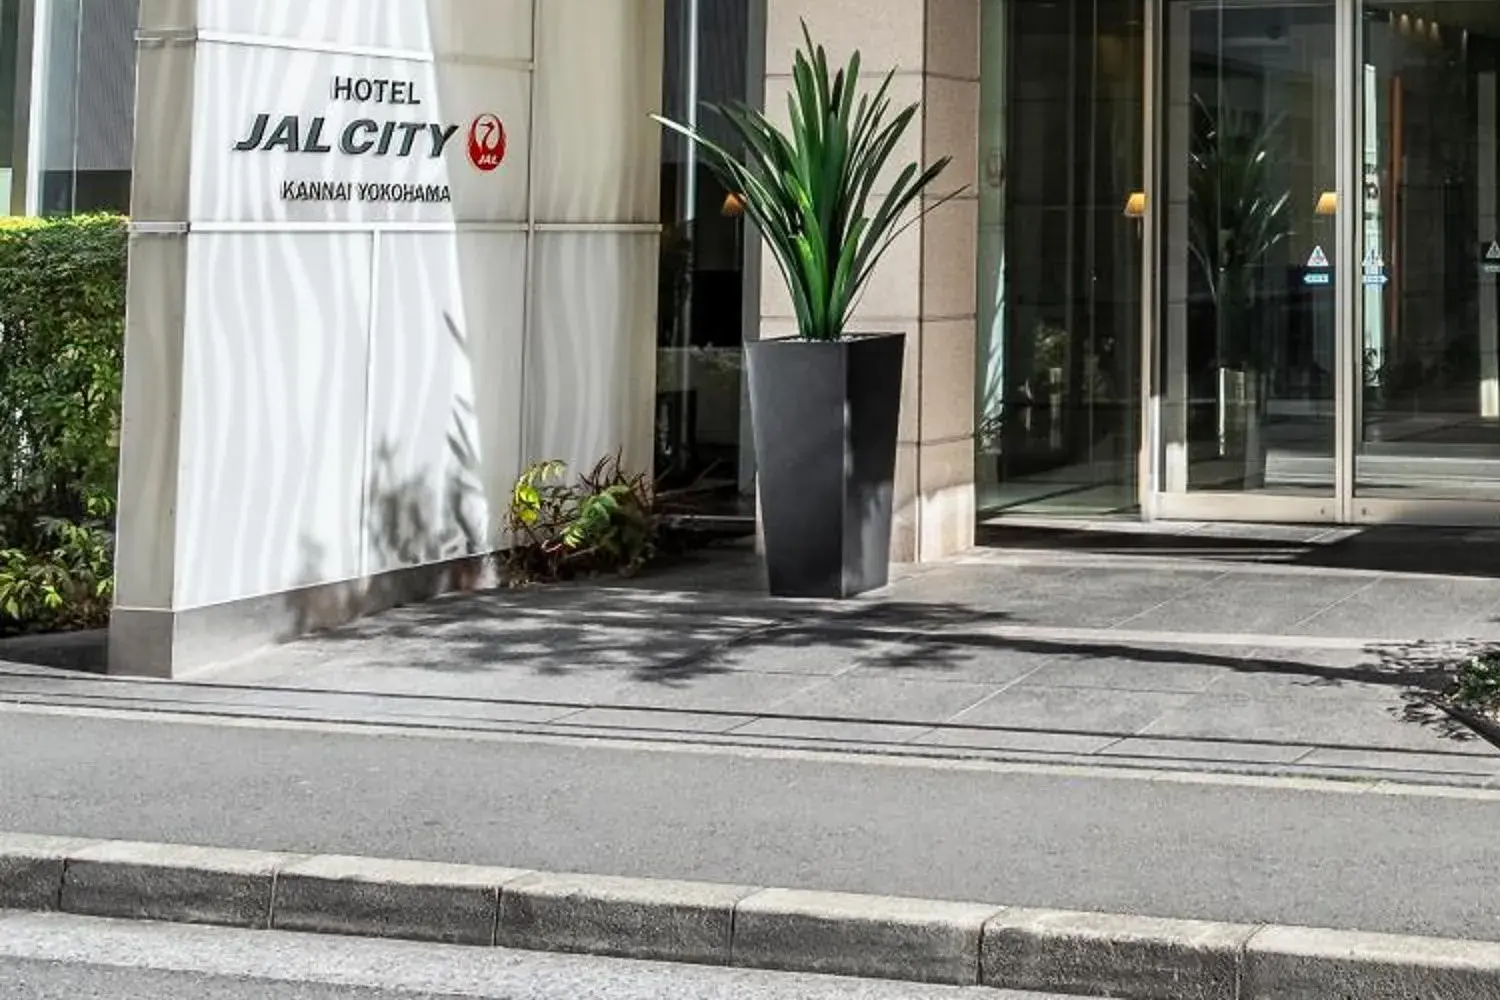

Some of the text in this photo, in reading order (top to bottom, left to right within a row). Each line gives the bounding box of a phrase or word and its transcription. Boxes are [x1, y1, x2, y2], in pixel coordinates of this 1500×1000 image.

[333, 75, 421, 105] HOTEL
[232, 113, 459, 158] JAL CITY
[477, 153, 501, 165] JAL
[281, 179, 451, 203] KANNAI YOKOHAMA
